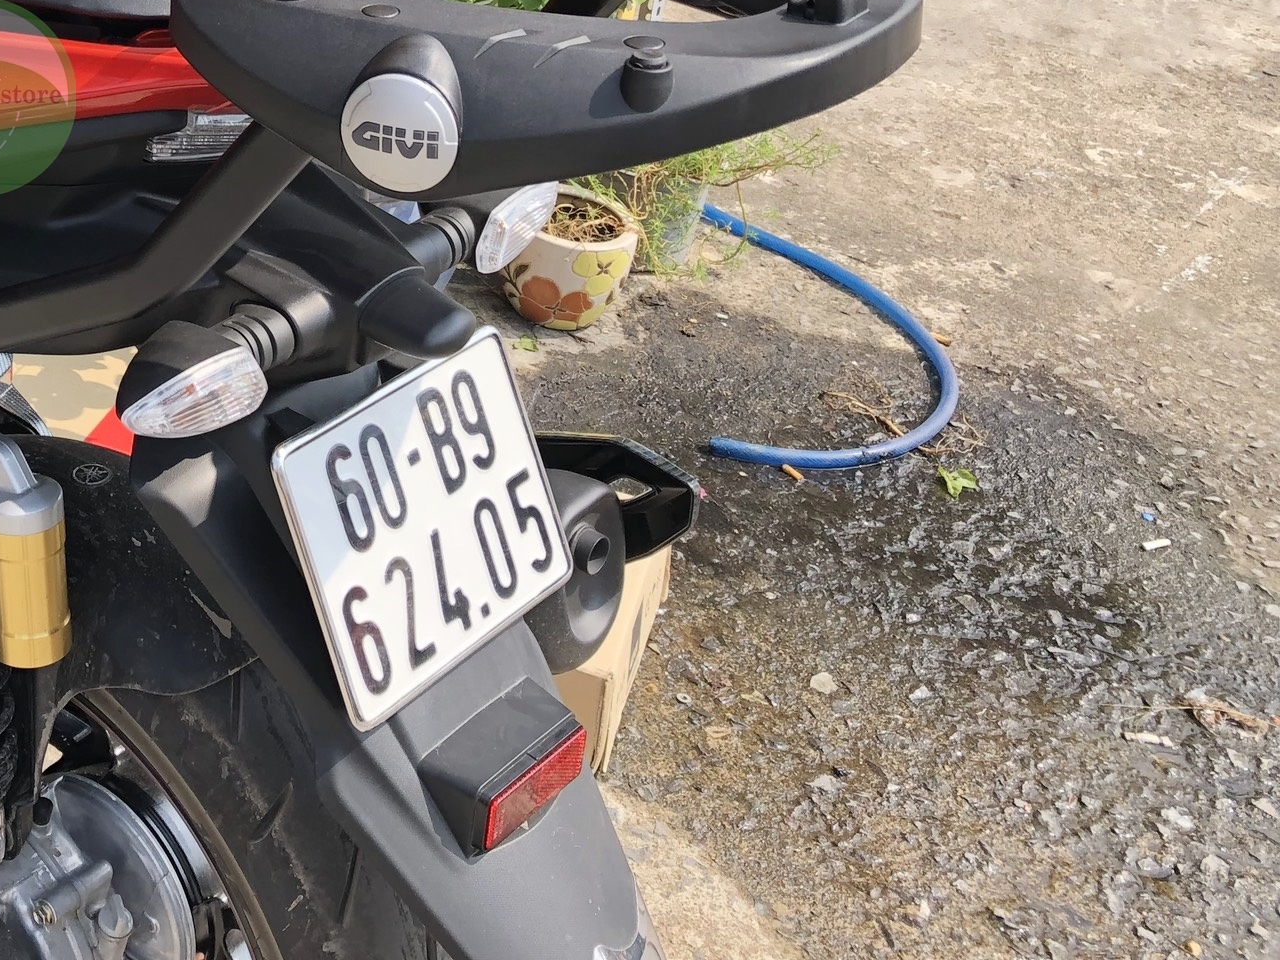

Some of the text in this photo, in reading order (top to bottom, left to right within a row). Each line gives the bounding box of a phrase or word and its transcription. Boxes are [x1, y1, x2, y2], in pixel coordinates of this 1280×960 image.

[351, 121, 439, 160] GIVI
[324, 369, 497, 553] 60-B9
[341, 467, 554, 696] 624.05
